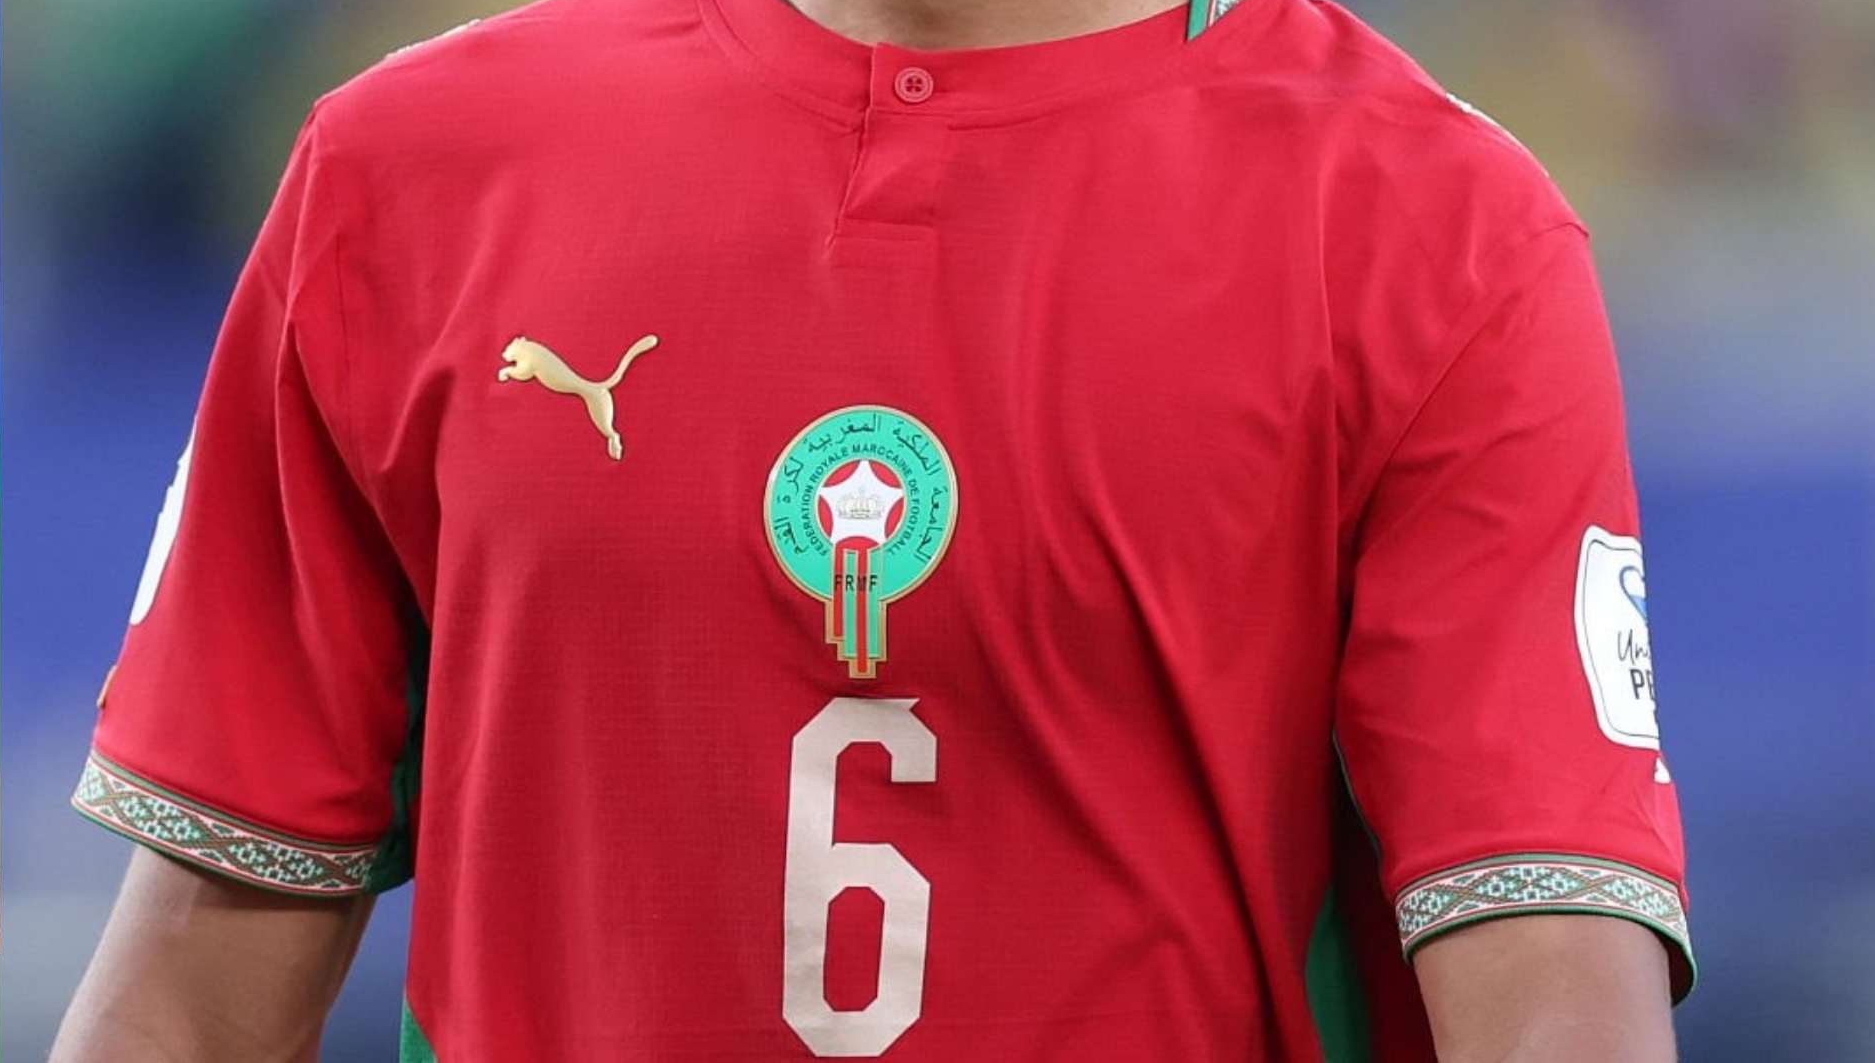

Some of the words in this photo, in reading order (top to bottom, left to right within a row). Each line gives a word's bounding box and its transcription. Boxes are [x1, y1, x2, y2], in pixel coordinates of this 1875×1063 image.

[809, 446, 849, 483] ROYALE
[852, 442, 913, 477] MAROCAINE
[908, 478, 920, 497] DE
[888, 498, 920, 555] FOOTBALL
[833, 573, 879, 593] FRMF
[781, 696, 938, 1058] 6
